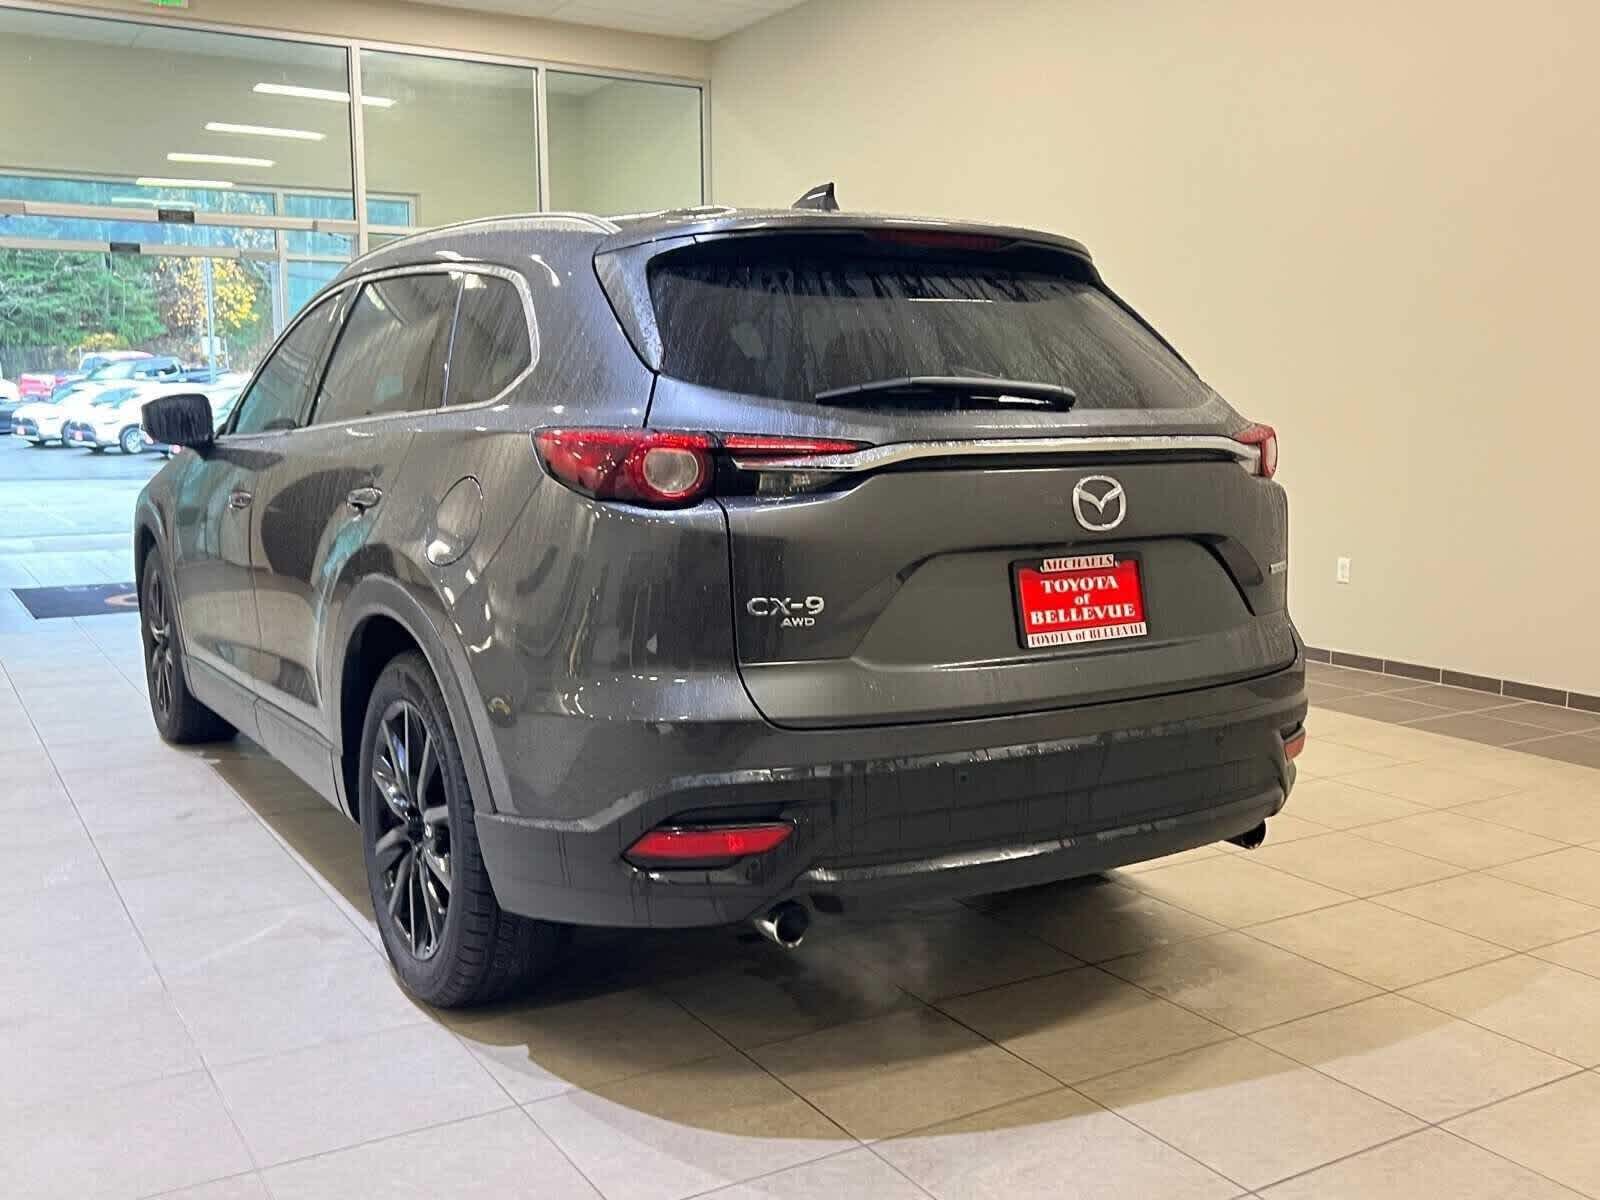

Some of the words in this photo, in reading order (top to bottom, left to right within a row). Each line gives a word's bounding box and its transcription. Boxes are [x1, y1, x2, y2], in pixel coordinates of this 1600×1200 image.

[1045, 555, 1113, 570] MICHAELS
[1041, 575, 1119, 594] TOYOTA
[746, 595, 825, 616] CX-9
[1074, 593, 1091, 606] of
[1030, 603, 1136, 625] BELLEVUE
[781, 617, 816, 628] AWD
[1030, 632, 1073, 646] TOYOTA
[1075, 631, 1087, 641] of
